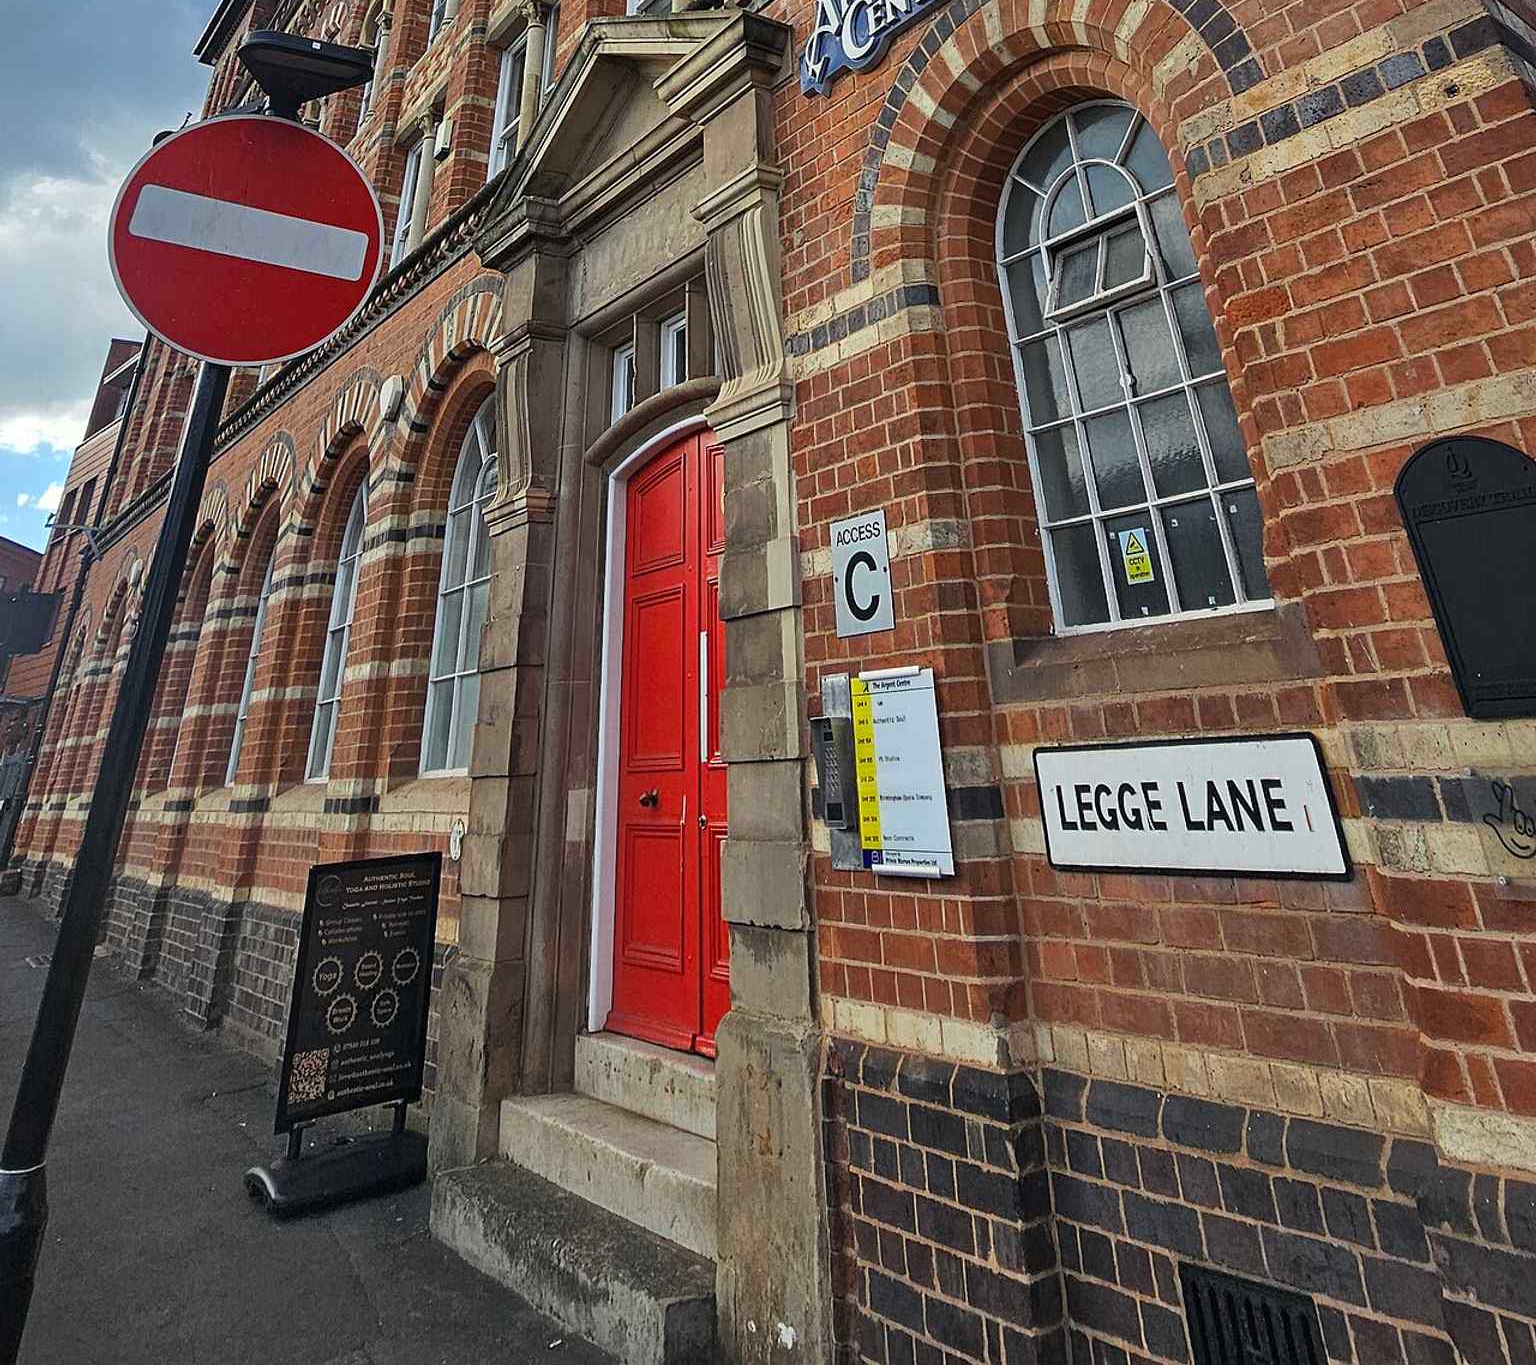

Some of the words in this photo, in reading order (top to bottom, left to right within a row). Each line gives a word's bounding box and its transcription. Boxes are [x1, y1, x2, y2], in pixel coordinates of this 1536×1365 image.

[836, 521, 881, 547] ACCESS
[1129, 556, 1145, 566] CCTV
[844, 550, 880, 622] C
[872, 681, 881, 689] The
[881, 680, 896, 690] Argent
[896, 679, 911, 687] Centre
[1055, 780, 1168, 832] LEGGE
[1176, 777, 1295, 832] LANE
[363, 873, 399, 883] AUTHENTIC
[345, 885, 364, 894] YOGA
[364, 884, 378, 892] AND
[318, 972, 337, 982] Yoga
